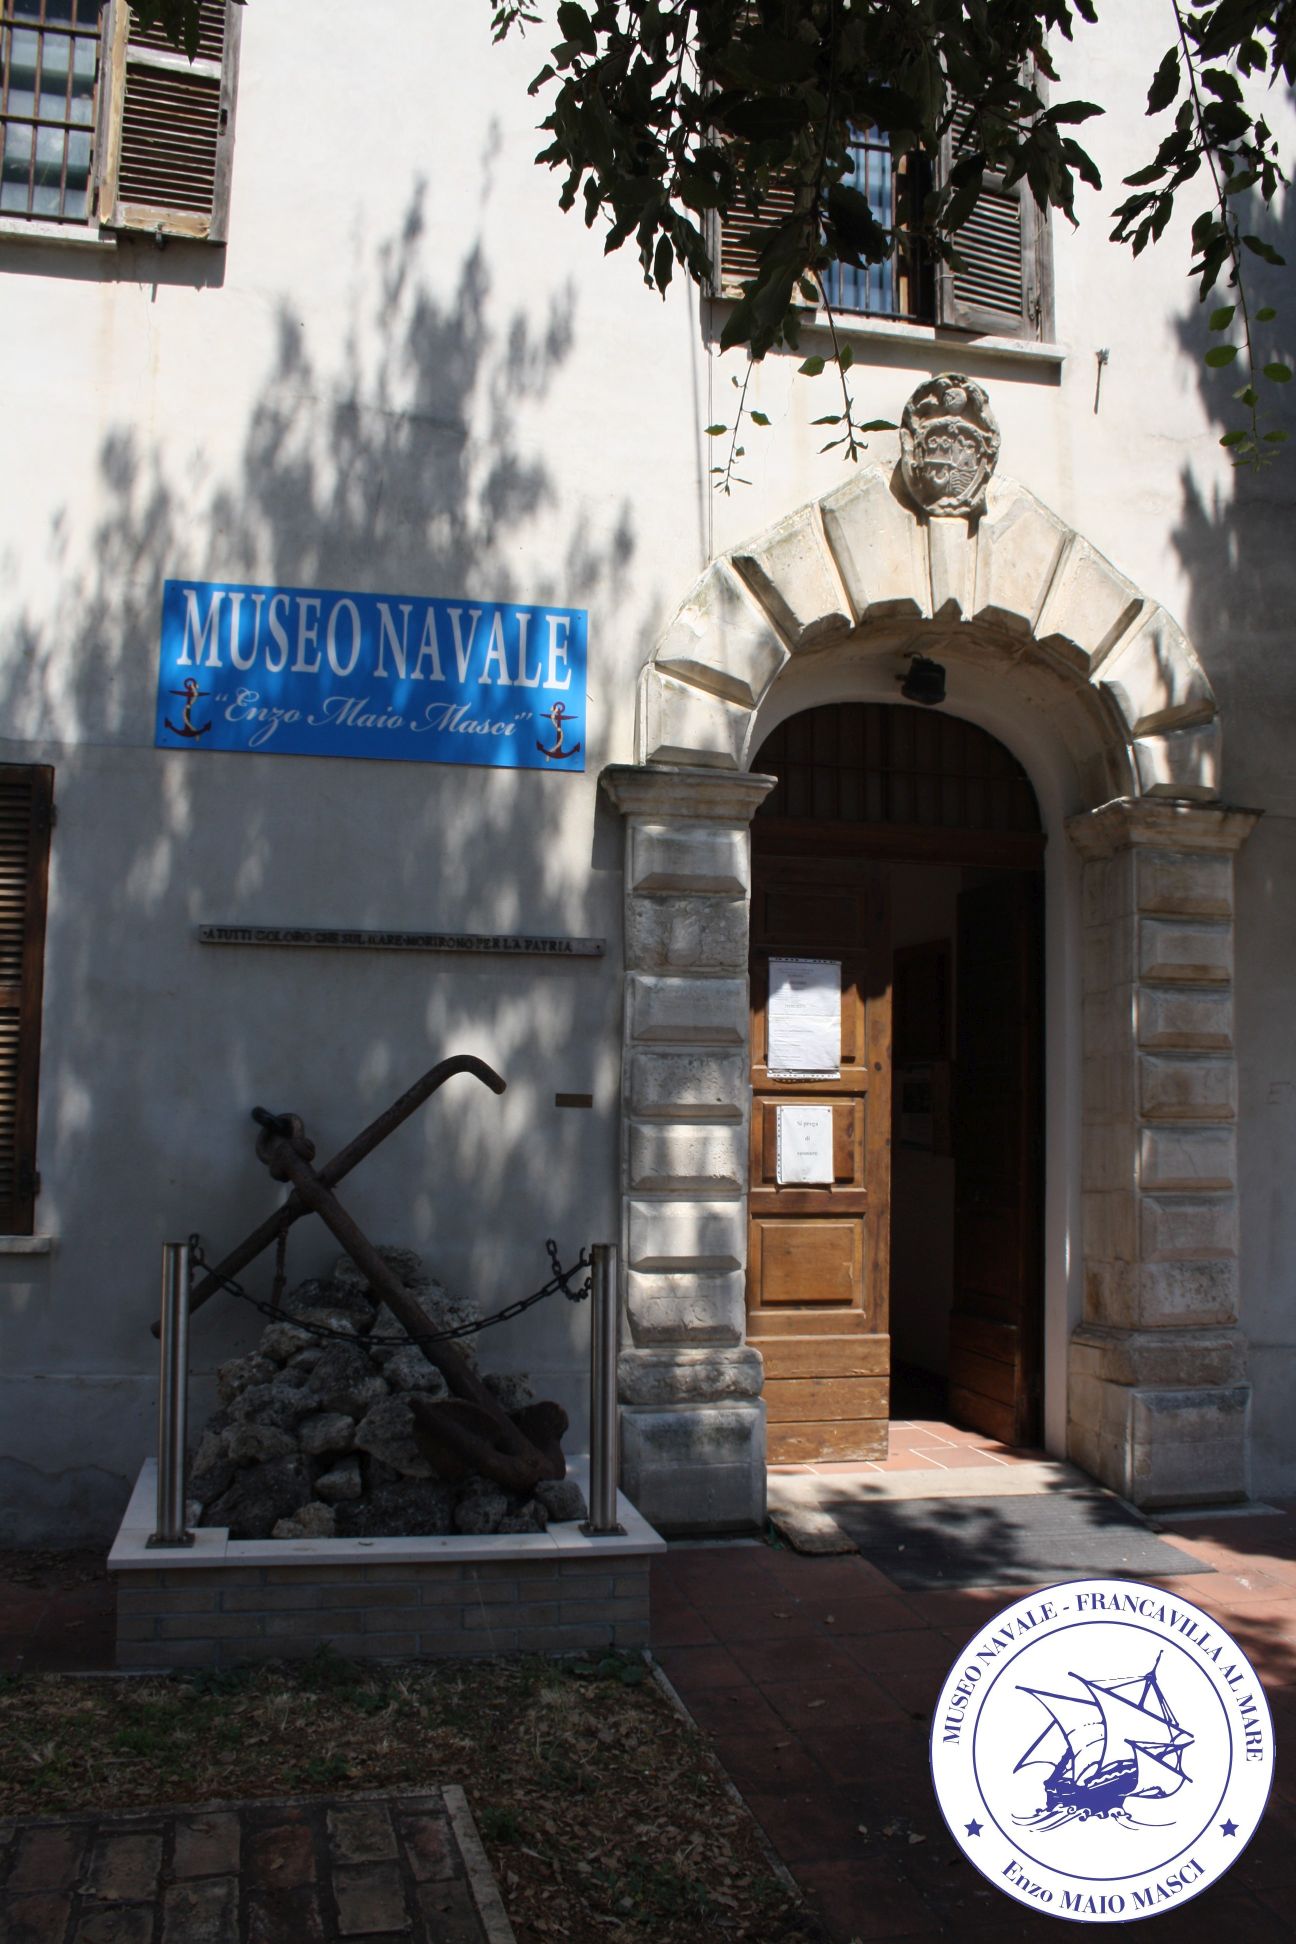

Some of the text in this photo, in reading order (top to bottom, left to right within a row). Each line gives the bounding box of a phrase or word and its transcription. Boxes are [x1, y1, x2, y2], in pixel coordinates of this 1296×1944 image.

[176, 589, 572, 691] MUSEO NAVALE
[307, 696, 404, 729] Maio
[524, 939, 573, 952] PATRIA
